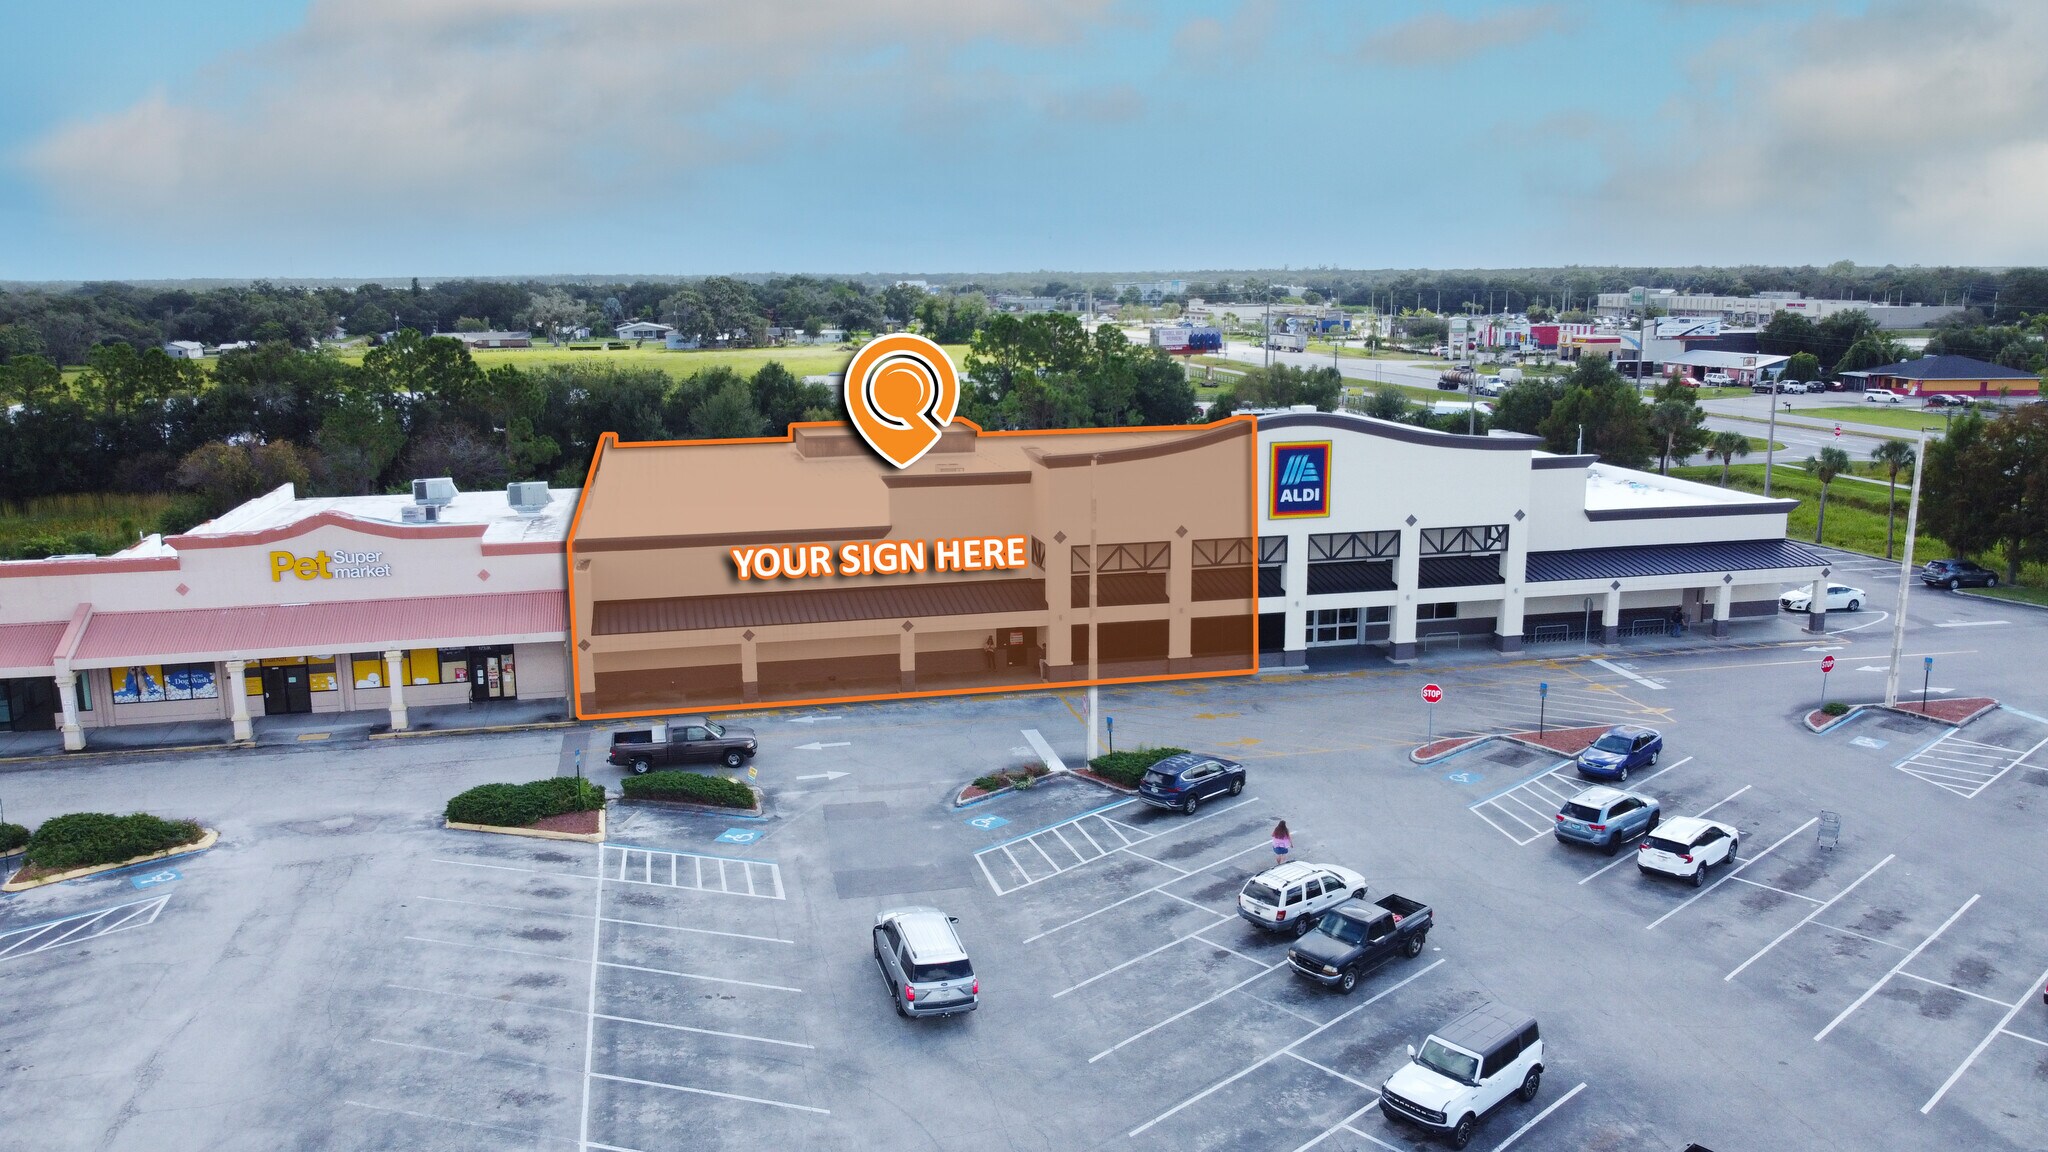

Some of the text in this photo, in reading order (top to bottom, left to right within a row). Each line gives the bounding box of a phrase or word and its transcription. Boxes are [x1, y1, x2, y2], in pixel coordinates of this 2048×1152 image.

[1280, 488, 1320, 502] ALDI
[334, 550, 382, 566] Super
[269, 550, 333, 582] Pet
[335, 563, 391, 578] market
[190, 676, 209, 684] Wash
[1423, 690, 1441, 698] STOP
